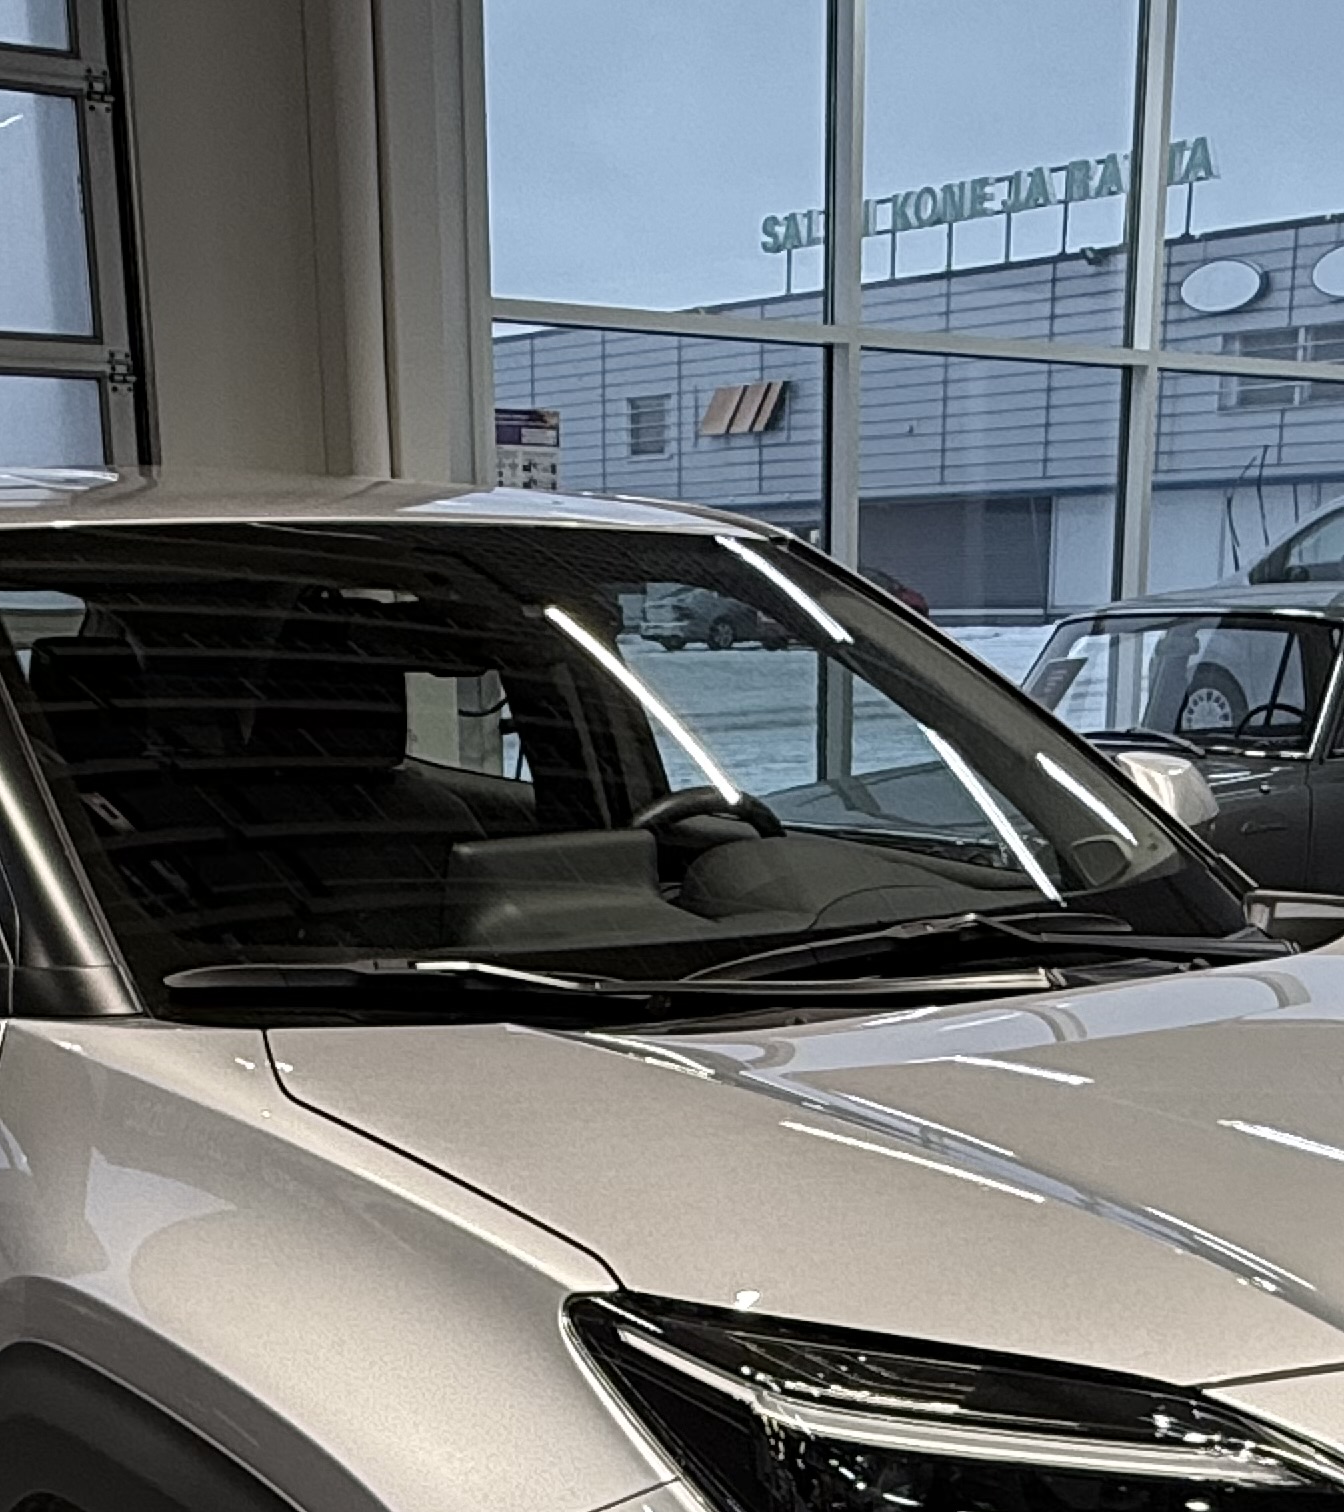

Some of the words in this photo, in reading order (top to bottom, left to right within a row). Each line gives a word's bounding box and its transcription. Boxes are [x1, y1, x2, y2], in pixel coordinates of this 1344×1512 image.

[760, 199, 876, 253] SAL
[891, 176, 994, 231] KONE
[1003, 166, 1055, 213] JA
[1066, 136, 1219, 201] RATA
